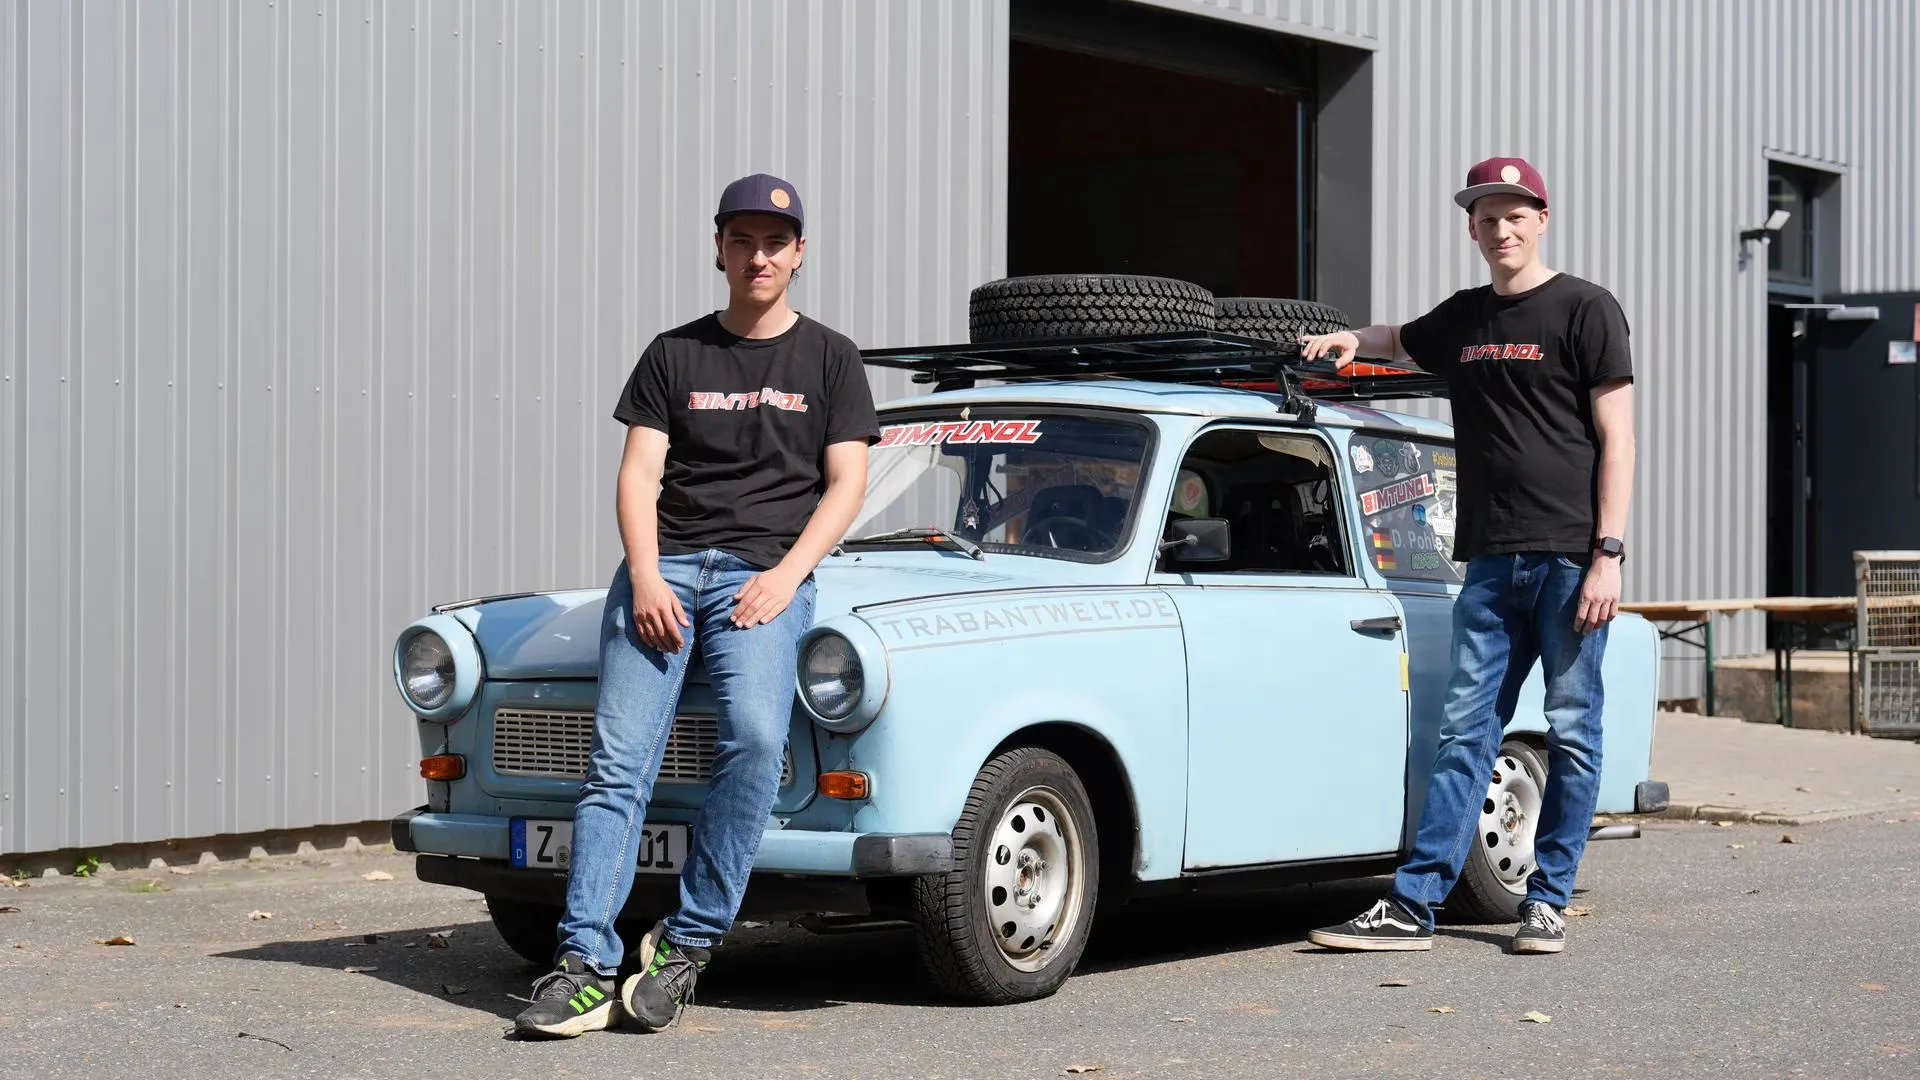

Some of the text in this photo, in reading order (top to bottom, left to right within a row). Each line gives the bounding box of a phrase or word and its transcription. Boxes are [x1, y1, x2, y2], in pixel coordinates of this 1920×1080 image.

[1461, 344, 1544, 362] BIMTUNOL
[688, 387, 808, 412] BIMTUNOL
[873, 420, 1043, 449] BIMTUNOL
[1360, 473, 1435, 516] BIMTUNOL
[1391, 529, 1406, 549] D.
[882, 598, 1176, 640] TRABANTWELT.DE
[516, 848, 523, 860] D
[536, 825, 554, 863] Z
